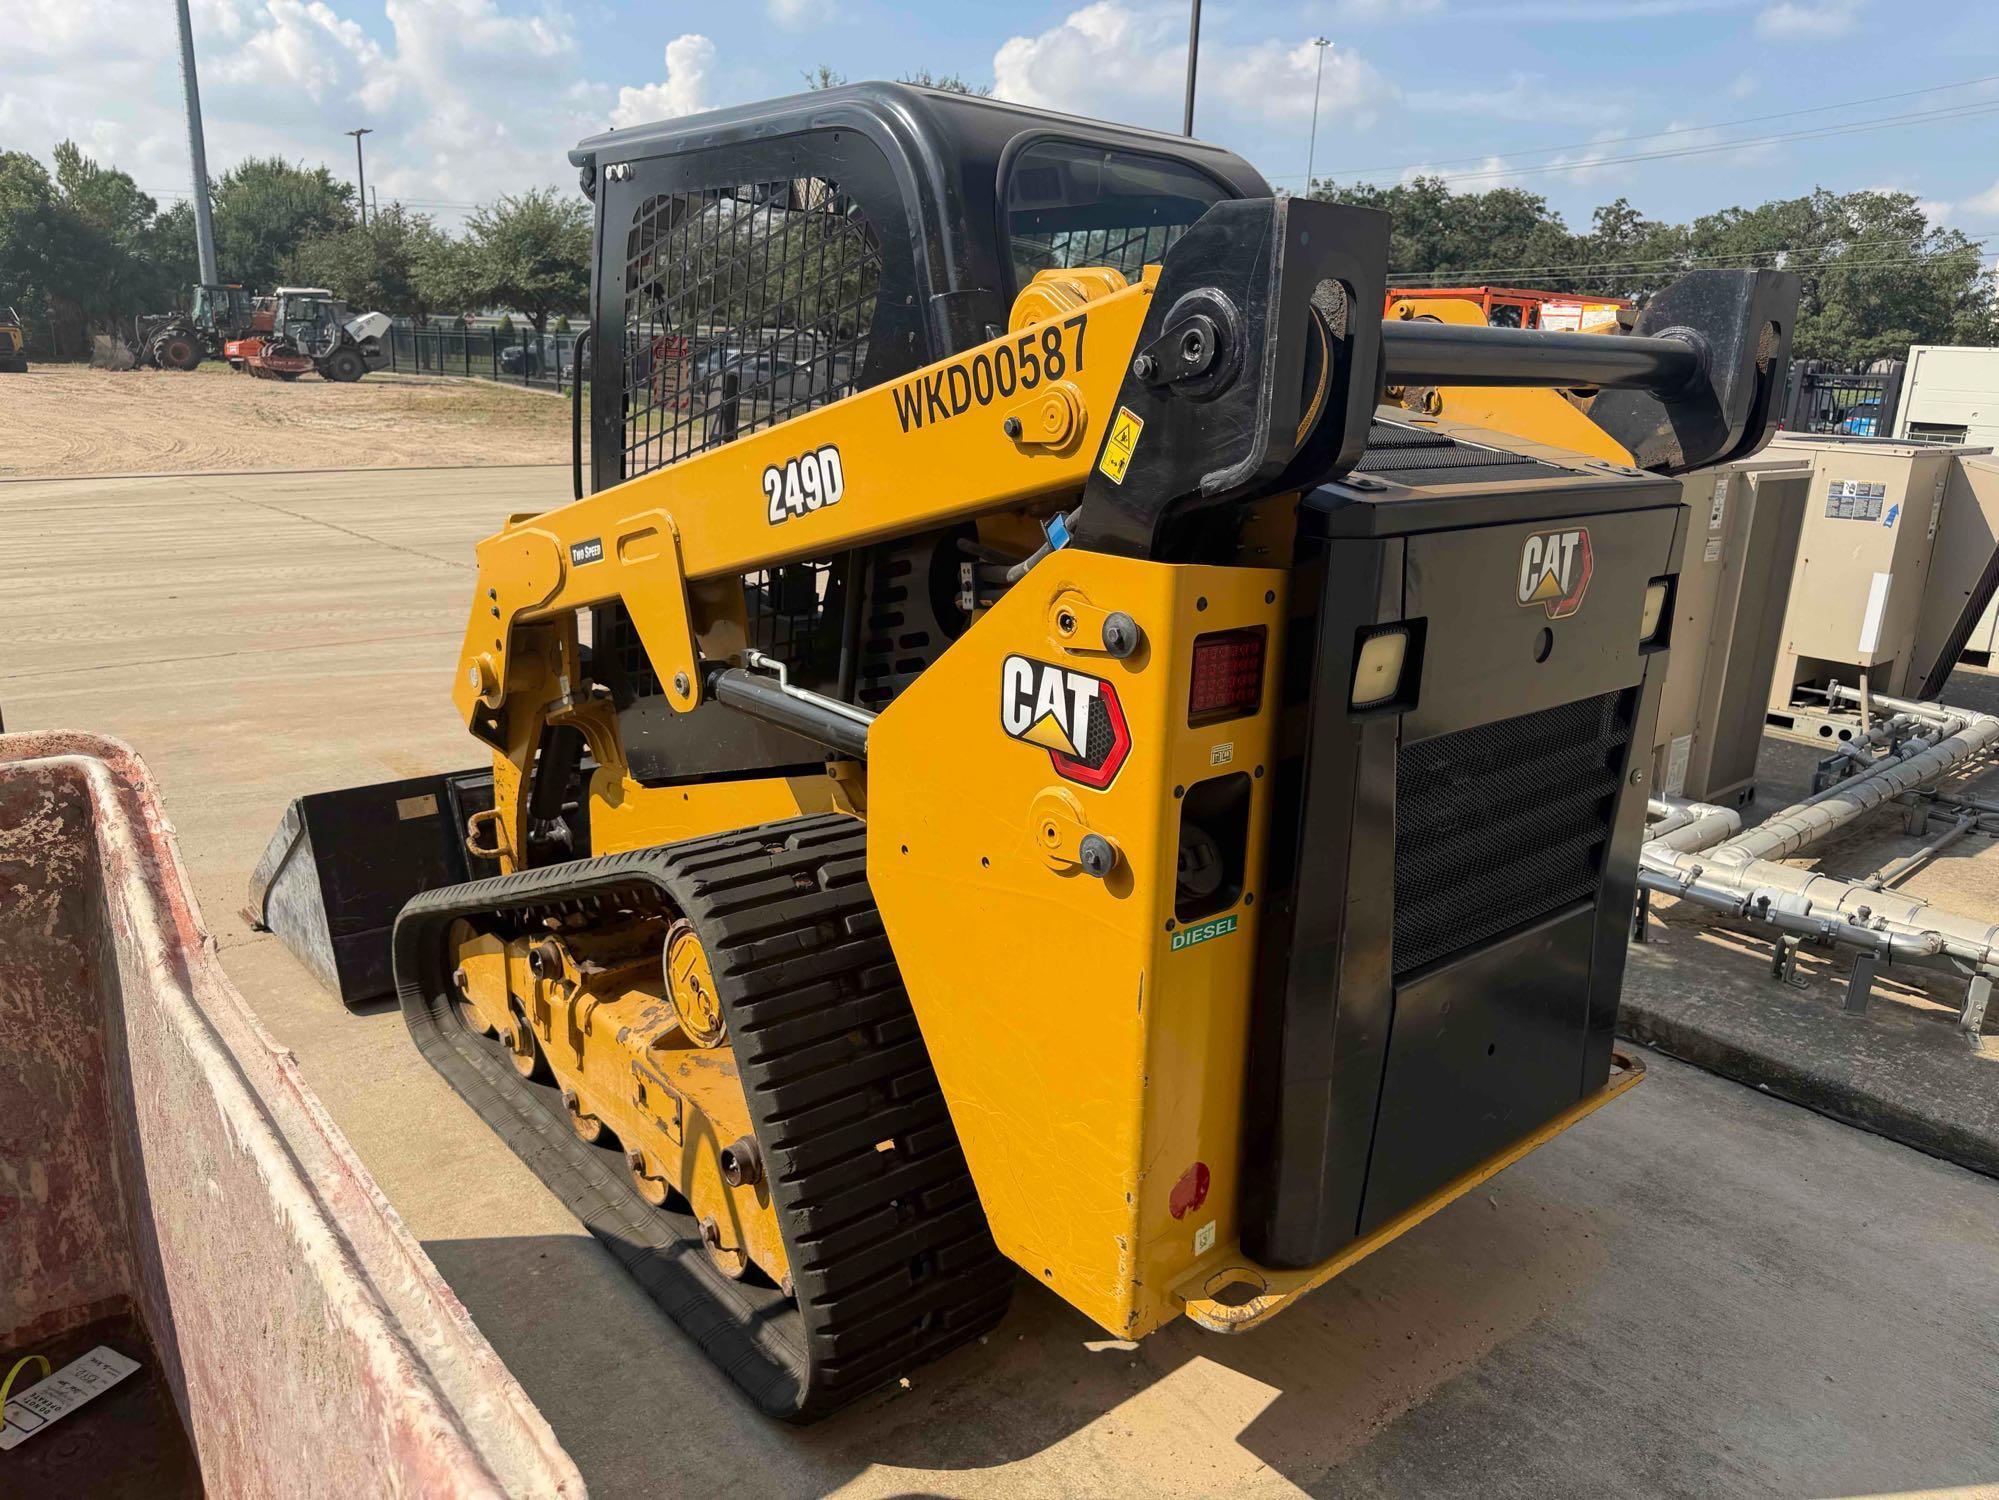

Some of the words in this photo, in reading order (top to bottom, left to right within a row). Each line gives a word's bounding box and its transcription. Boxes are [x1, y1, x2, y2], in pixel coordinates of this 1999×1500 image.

[893, 313, 1087, 433] WKD00587
[763, 447, 844, 523] 249D
[1519, 532, 1580, 602] CAT
[1003, 656, 1099, 758] CAT
[1172, 918, 1237, 950] DIESEL
[29, 1391, 62, 1412] OPERATE
